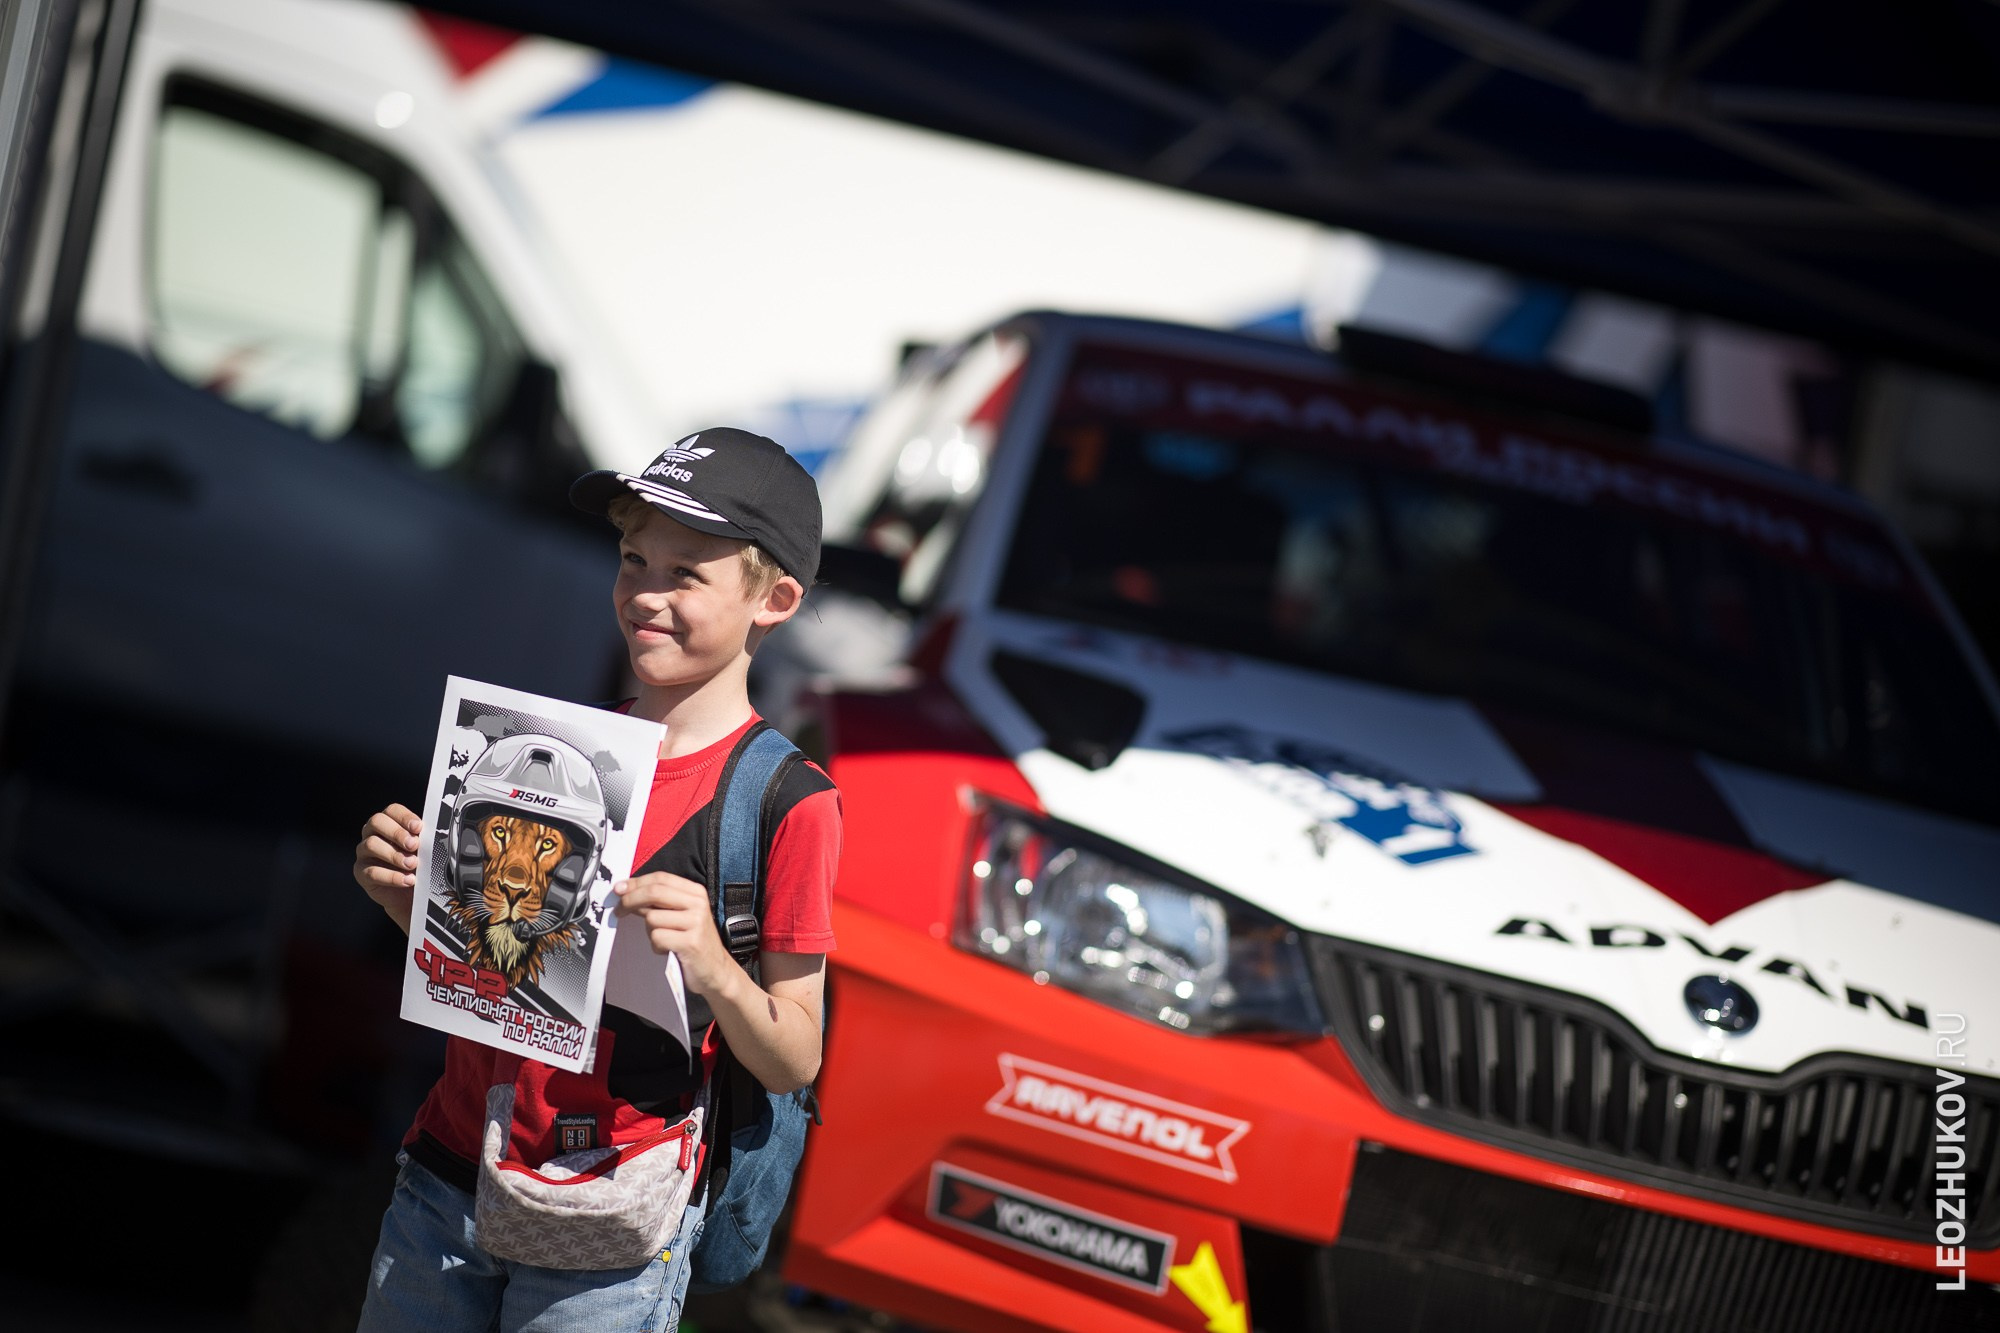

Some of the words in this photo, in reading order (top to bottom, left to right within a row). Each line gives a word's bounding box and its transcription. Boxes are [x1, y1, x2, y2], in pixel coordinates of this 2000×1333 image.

[643, 462, 693, 482] adidas
[1495, 917, 1931, 1032] ADVAN
[427, 984, 521, 1022] ЧЕМПИОНАТ
[523, 1013, 587, 1043] РОССИИ
[503, 1022, 526, 1042] ПО
[529, 1030, 583, 1059] РАЛЛИ
[1014, 1075, 1214, 1159] RAVENOL
[994, 1199, 1150, 1277] YOKOHAMA
